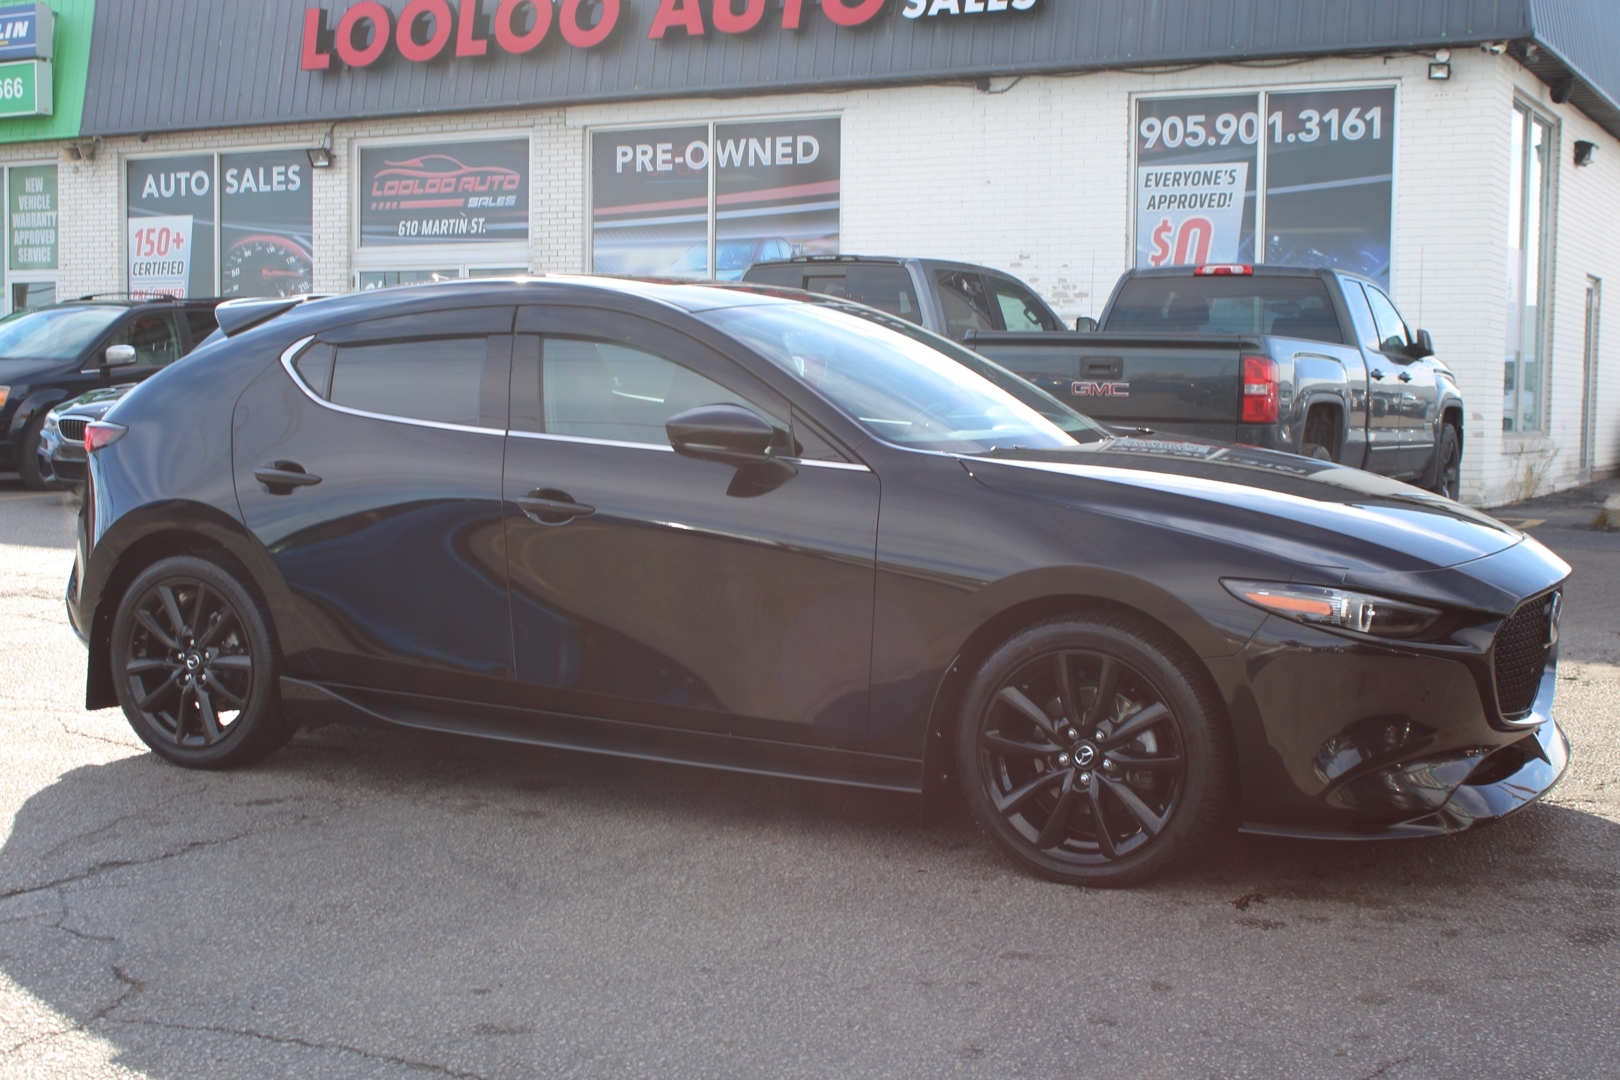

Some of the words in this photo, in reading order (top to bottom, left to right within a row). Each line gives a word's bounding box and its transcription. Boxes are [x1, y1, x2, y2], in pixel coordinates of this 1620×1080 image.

[301, 0, 620, 71] LOOLOO
[0, 77, 23, 99] 66
[1140, 107, 1381, 148] 905.901.3161
[616, 135, 820, 173] PRE-OWNED
[25, 176, 44, 193] NEW
[142, 170, 210, 199] AUTO
[225, 164, 301, 194] SALES
[371, 178, 456, 197] LOOLOO
[458, 175, 520, 193] AUTO
[1144, 169, 1237, 189] EVERYONE'S
[18, 194, 51, 211] VEHICLE
[467, 195, 517, 208] SALES
[1146, 192, 1234, 211] APPROVED!
[12, 212, 57, 228] WARRANTY
[398, 220, 419, 237] 610
[421, 218, 468, 236] MARTIN
[470, 217, 487, 234] ST.
[14, 229, 56, 246] APPROVED
[134, 227, 185, 258] 150+
[18, 247, 52, 263] SERVICE
[132, 260, 185, 277] CERTIFIED
[132, 288, 185, 300] PREOWNED
[1071, 381, 1130, 398] GMC
